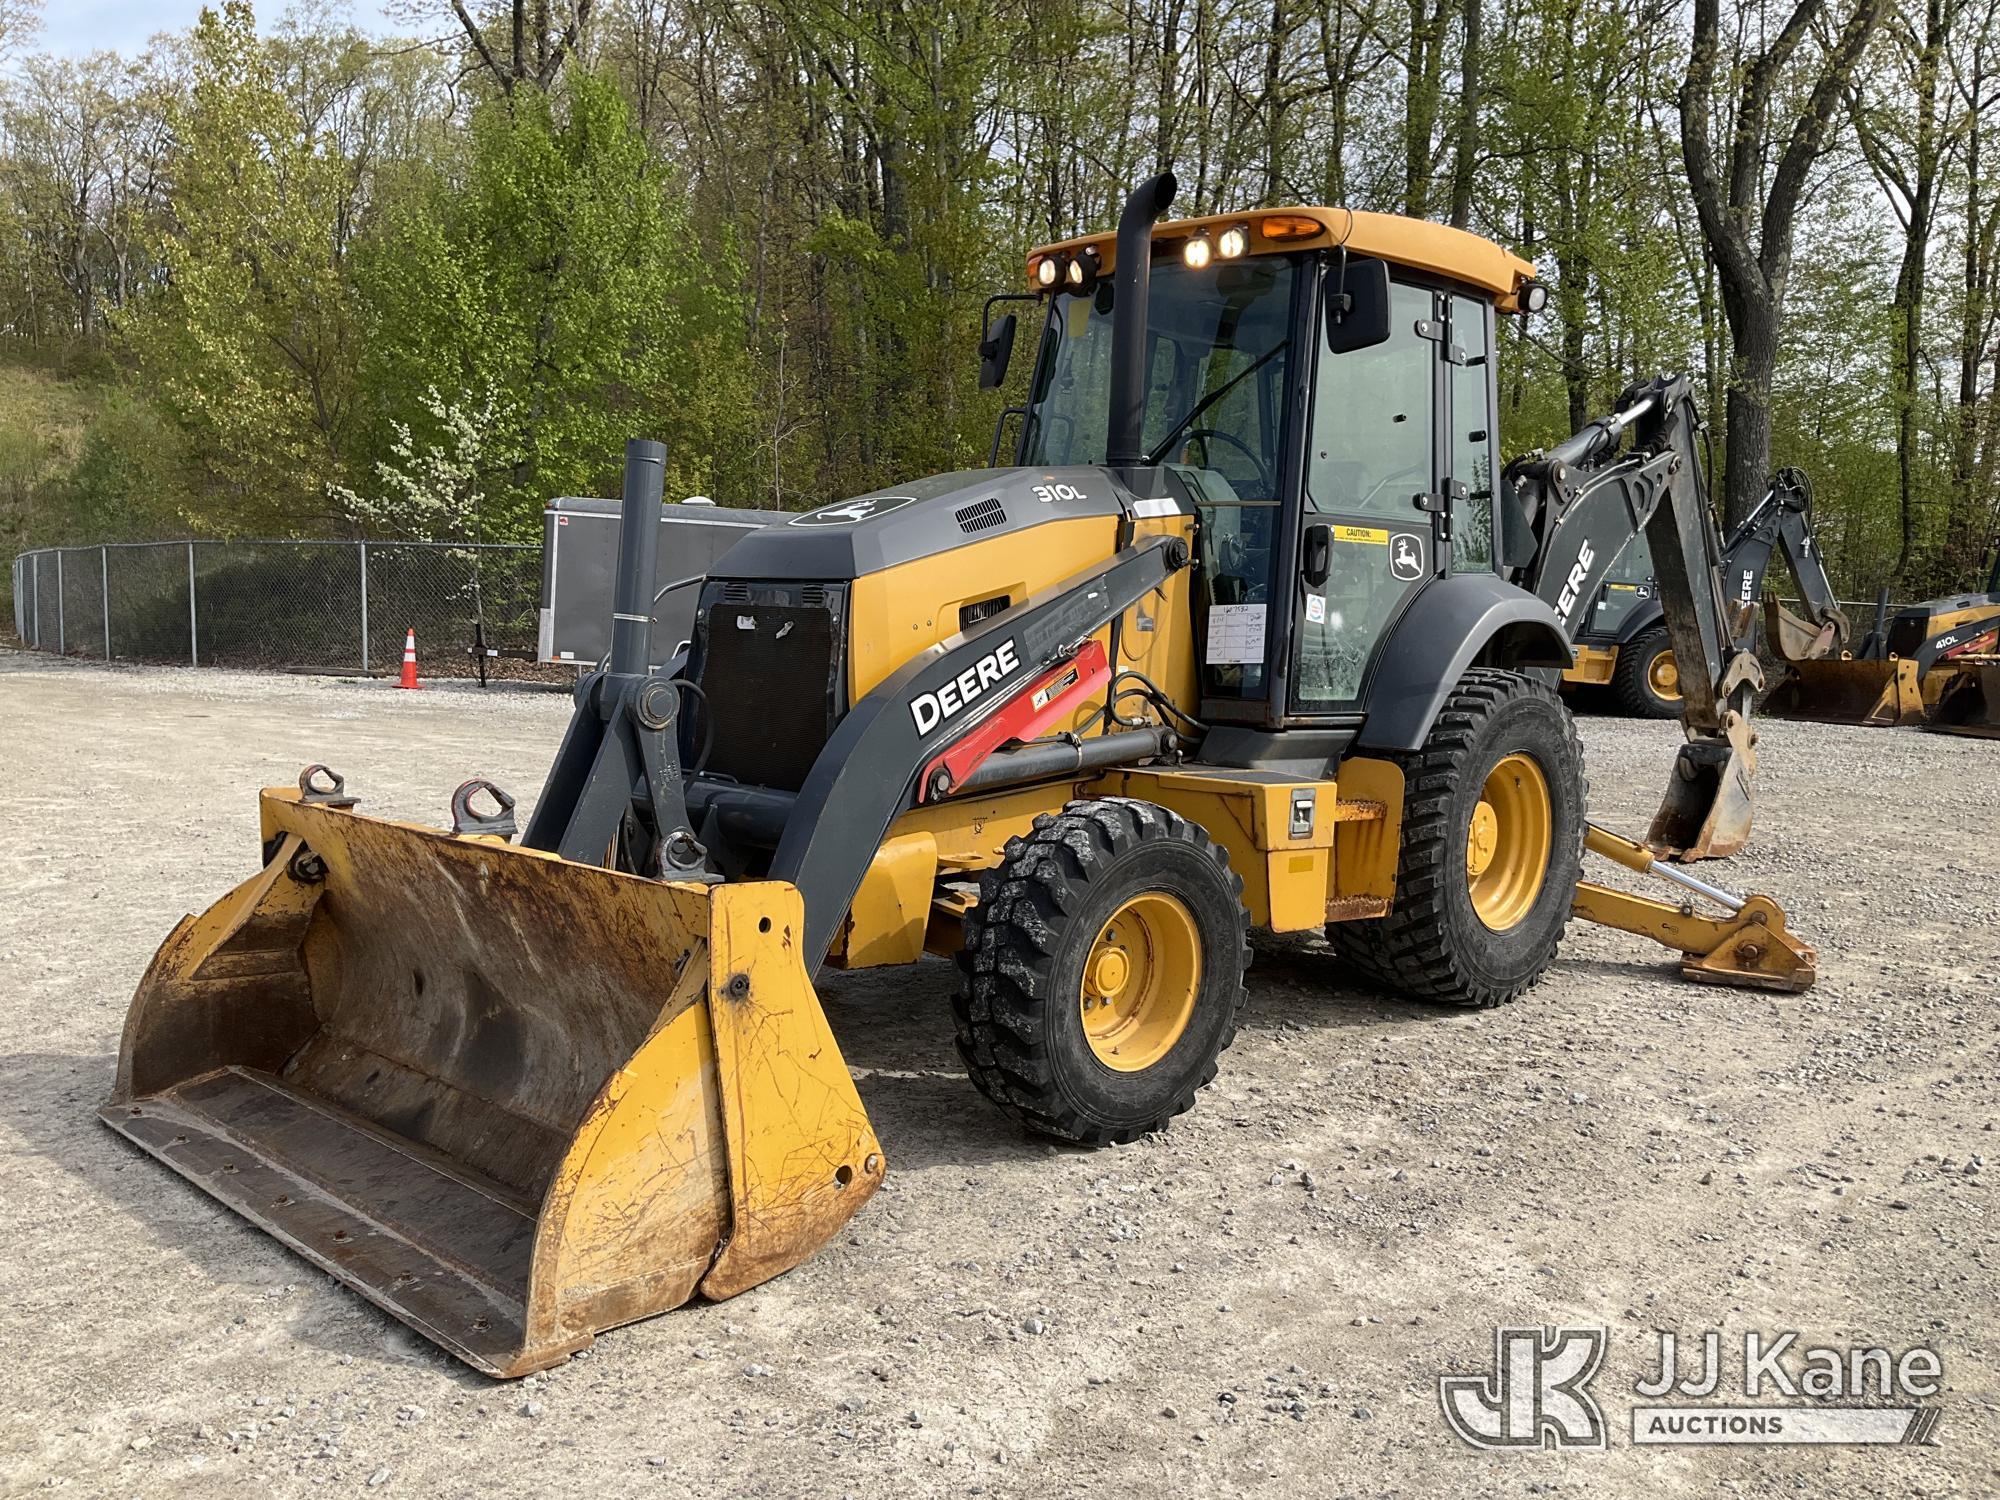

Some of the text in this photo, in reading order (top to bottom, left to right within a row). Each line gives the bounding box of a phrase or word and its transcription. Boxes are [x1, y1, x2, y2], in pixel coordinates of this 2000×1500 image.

[1031, 484, 1088, 503] 310L
[1346, 527, 1372, 538] CAUTION:
[1935, 635, 1959, 649] 410L
[910, 638, 1020, 738] DEERE
